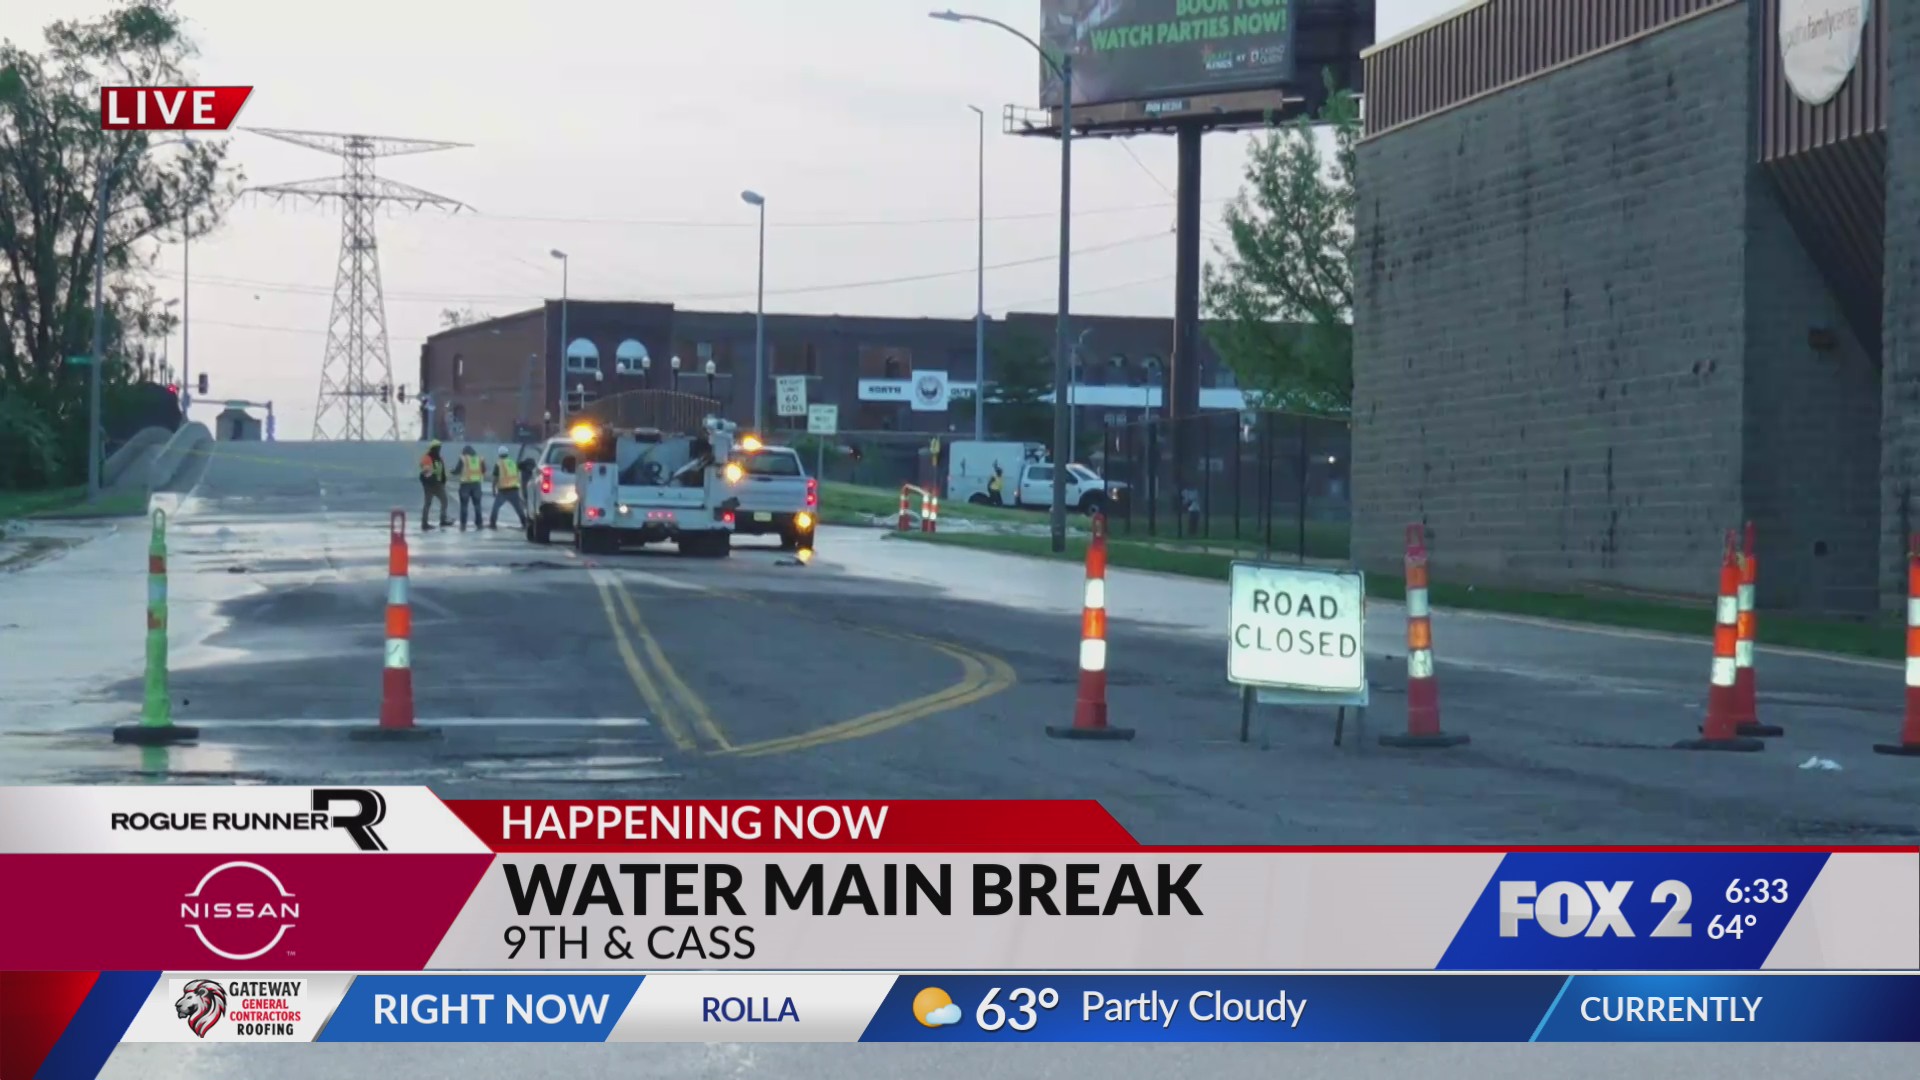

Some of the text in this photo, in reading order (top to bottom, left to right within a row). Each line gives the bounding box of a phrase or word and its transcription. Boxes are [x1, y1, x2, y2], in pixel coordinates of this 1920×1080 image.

[1090, 10, 1287, 50] WATCH PARTIES NOW!
[780, 404, 804, 412] TONS
[785, 394, 799, 403] 60
[1253, 589, 1338, 620] ROAD
[1235, 623, 1357, 658] CLOSED
